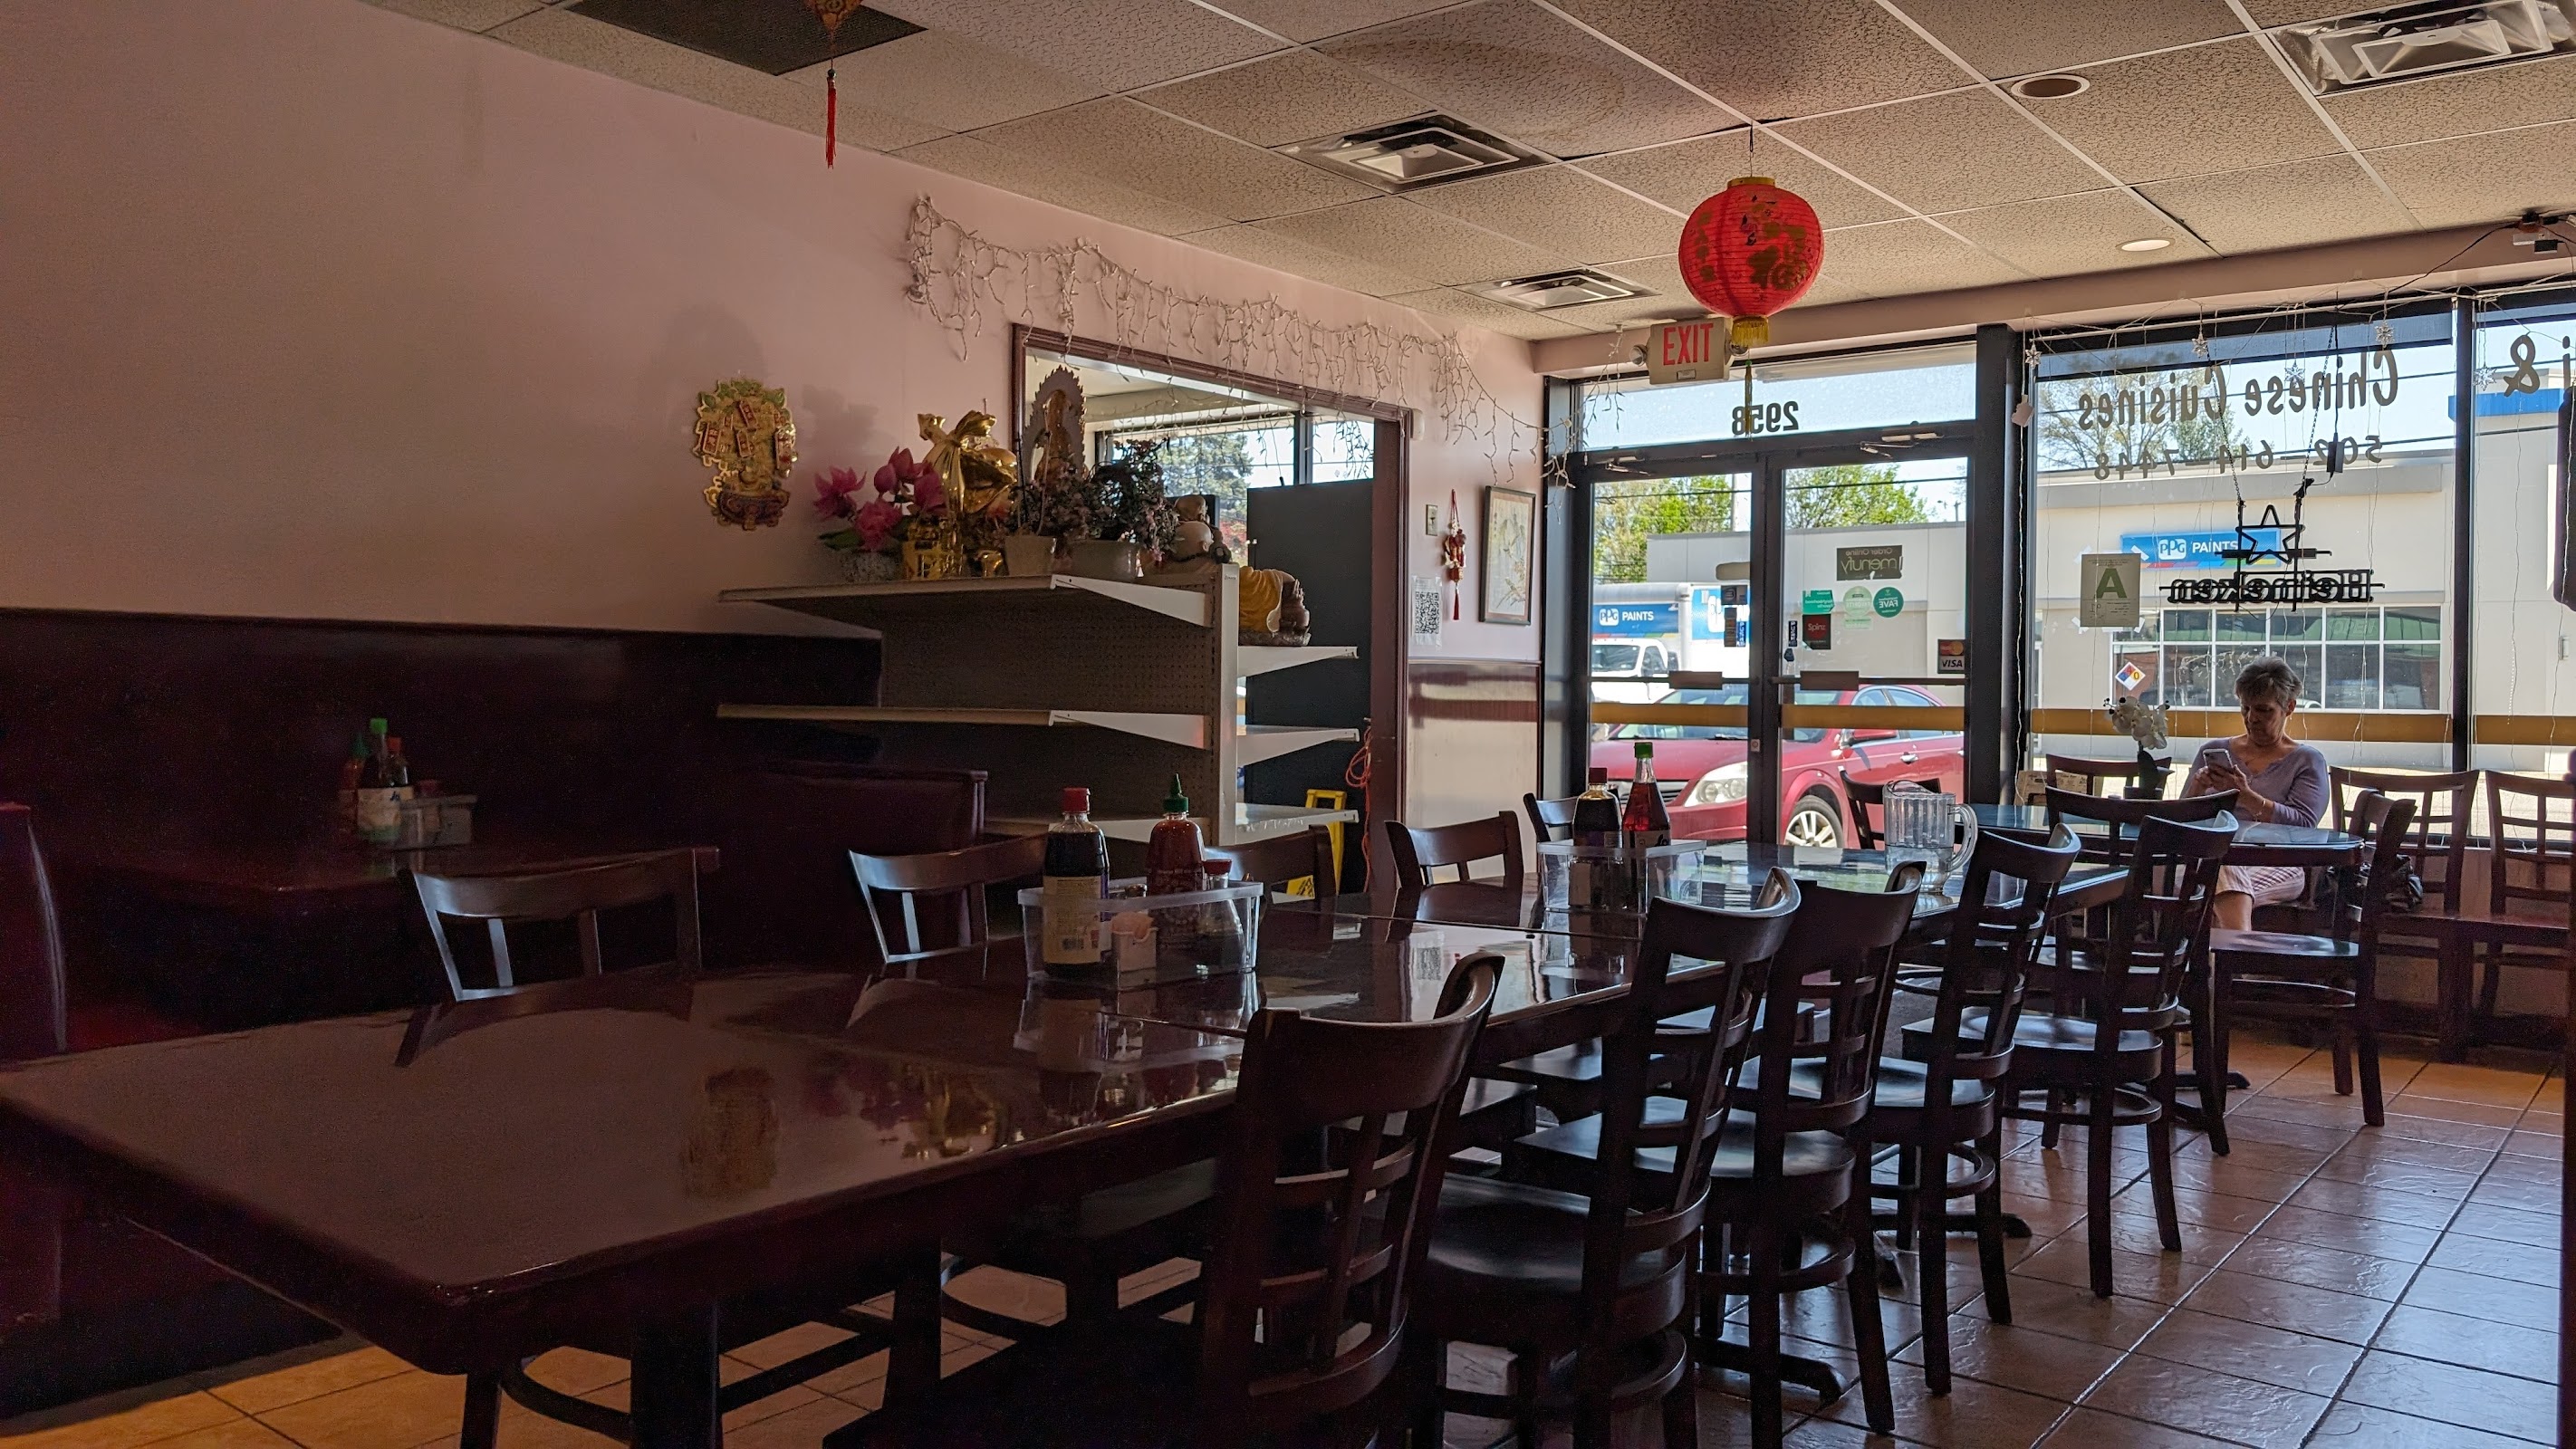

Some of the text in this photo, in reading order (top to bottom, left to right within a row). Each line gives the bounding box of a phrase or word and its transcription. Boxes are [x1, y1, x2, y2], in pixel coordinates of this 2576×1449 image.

[1662, 321, 1715, 367] EXIT
[2191, 540, 2239, 554] PAINTS
[1621, 611, 1655, 621] PAINTS
[1941, 659, 1963, 667] VISA
